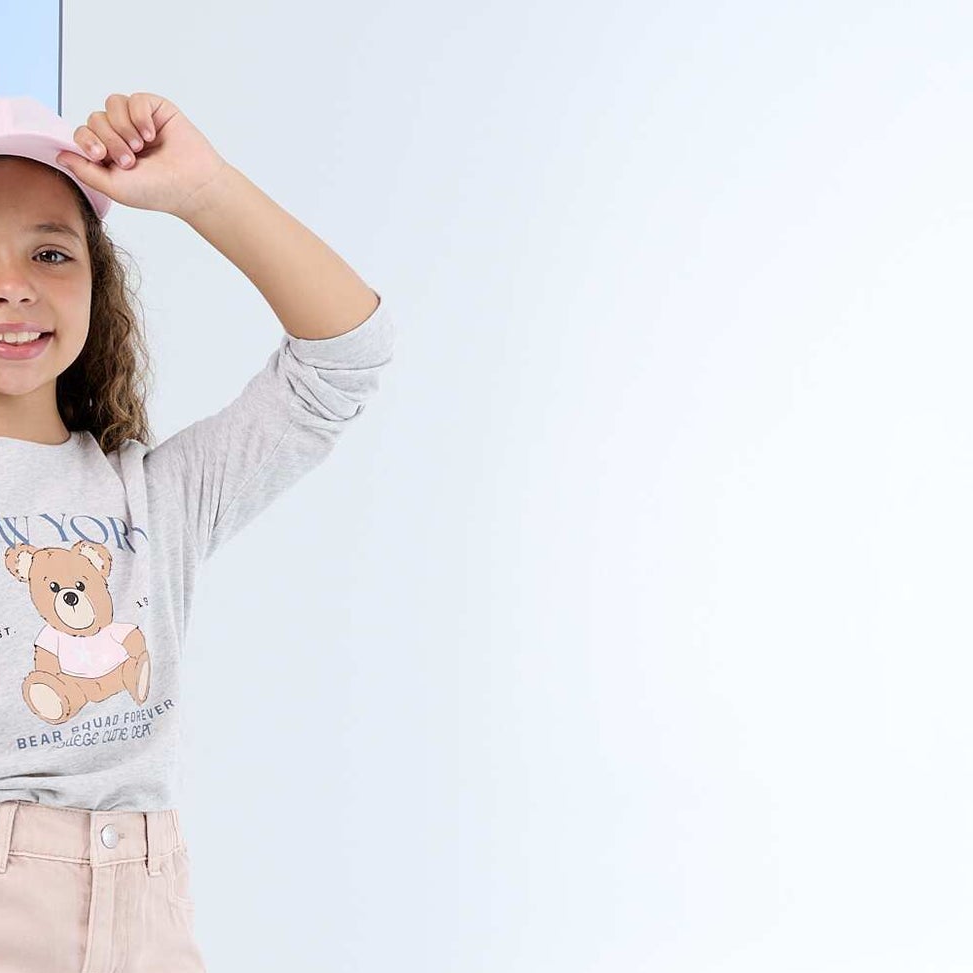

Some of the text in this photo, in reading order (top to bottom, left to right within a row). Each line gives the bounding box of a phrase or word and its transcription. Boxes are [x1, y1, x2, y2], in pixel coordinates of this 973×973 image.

[16, 730, 63, 749] BEAR
[123, 699, 175, 724] FOREVER
[102, 727, 129, 743] CUTIE
